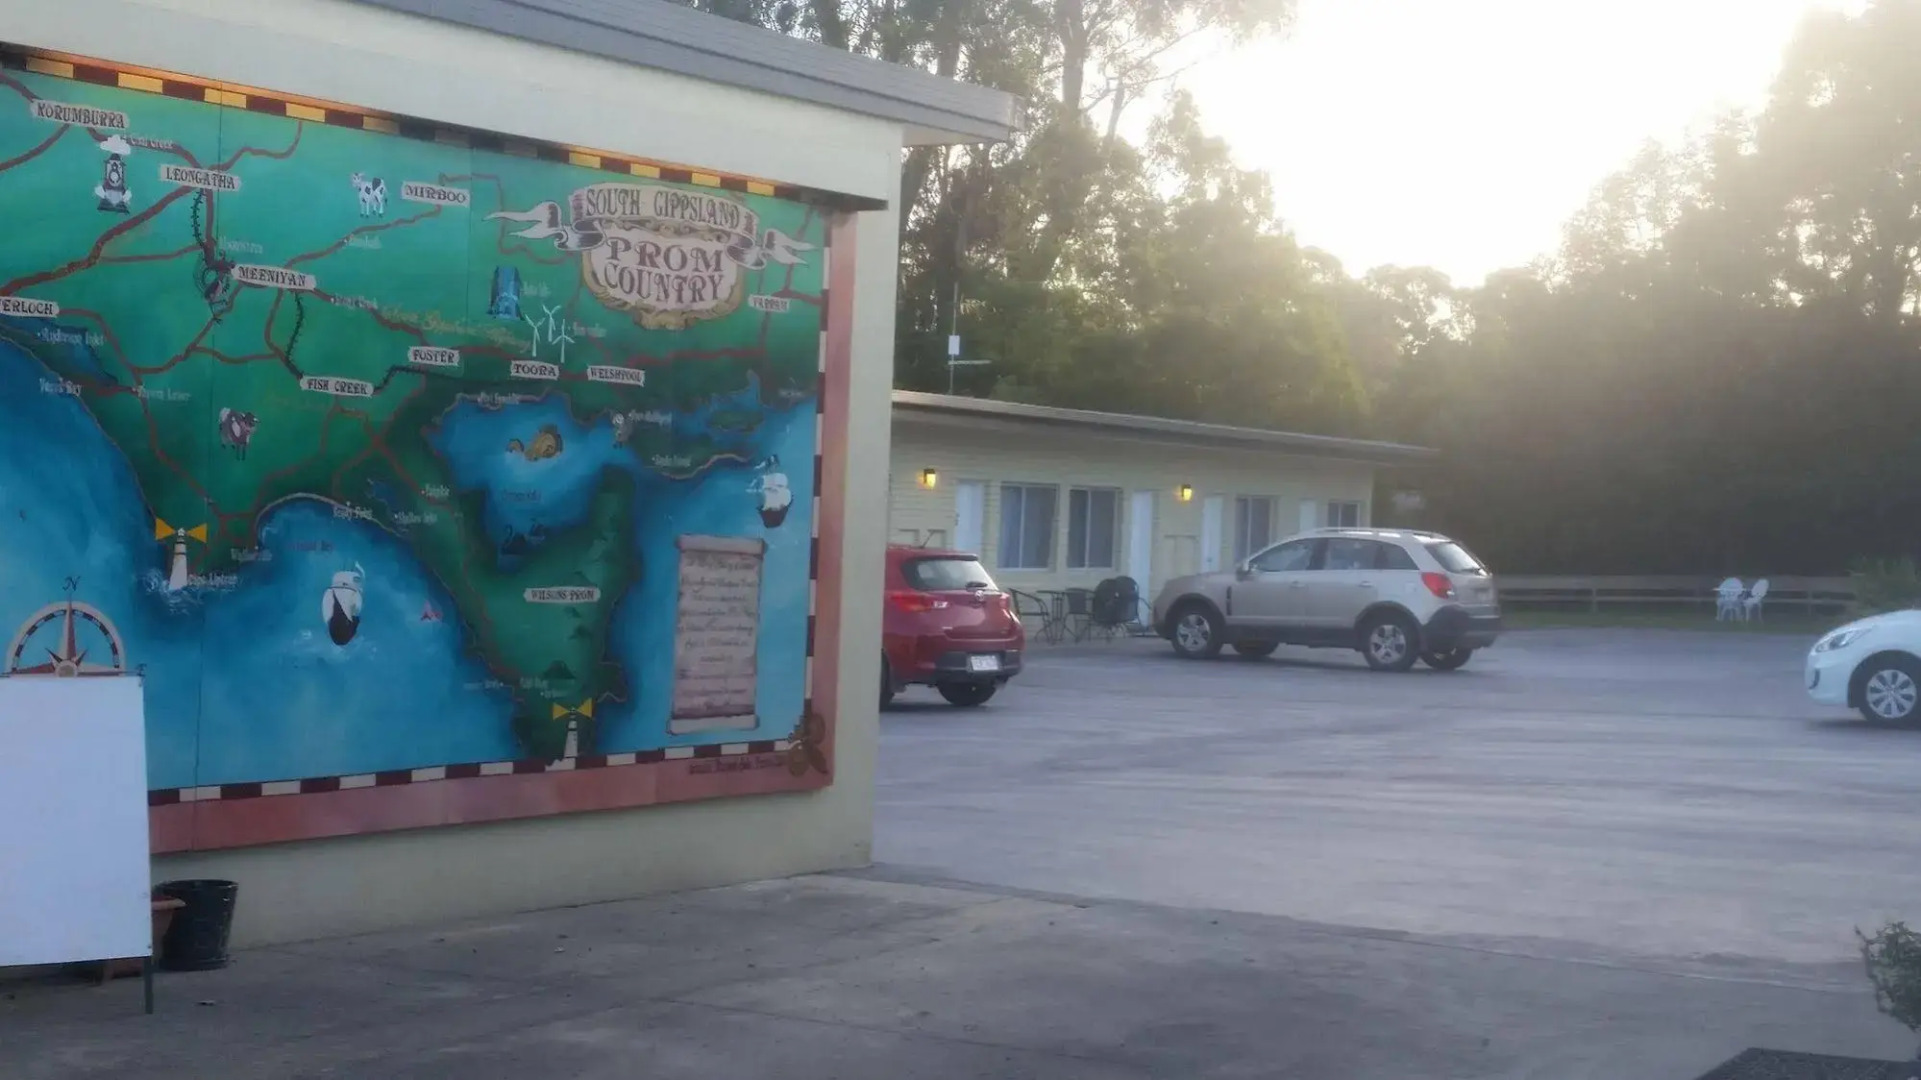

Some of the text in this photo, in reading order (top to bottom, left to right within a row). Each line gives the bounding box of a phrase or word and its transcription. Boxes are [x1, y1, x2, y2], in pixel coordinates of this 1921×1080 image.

[37, 103, 125, 128] KORUMBURRA
[166, 167, 236, 189] LEONGATHA
[404, 184, 467, 203] MIRBOO
[586, 188, 741, 229] SOUTH GIPPSLAND
[607, 237, 725, 272] PROM
[238, 266, 307, 288] MEENIYAN
[604, 263, 725, 304] COUNTRY
[0, 299, 53, 315] ERLOCH
[412, 350, 456, 364] FOSTER
[513, 363, 556, 377] TOORA
[590, 368, 643, 383] WELSHPOOL
[307, 380, 369, 395] FISH CREEK
